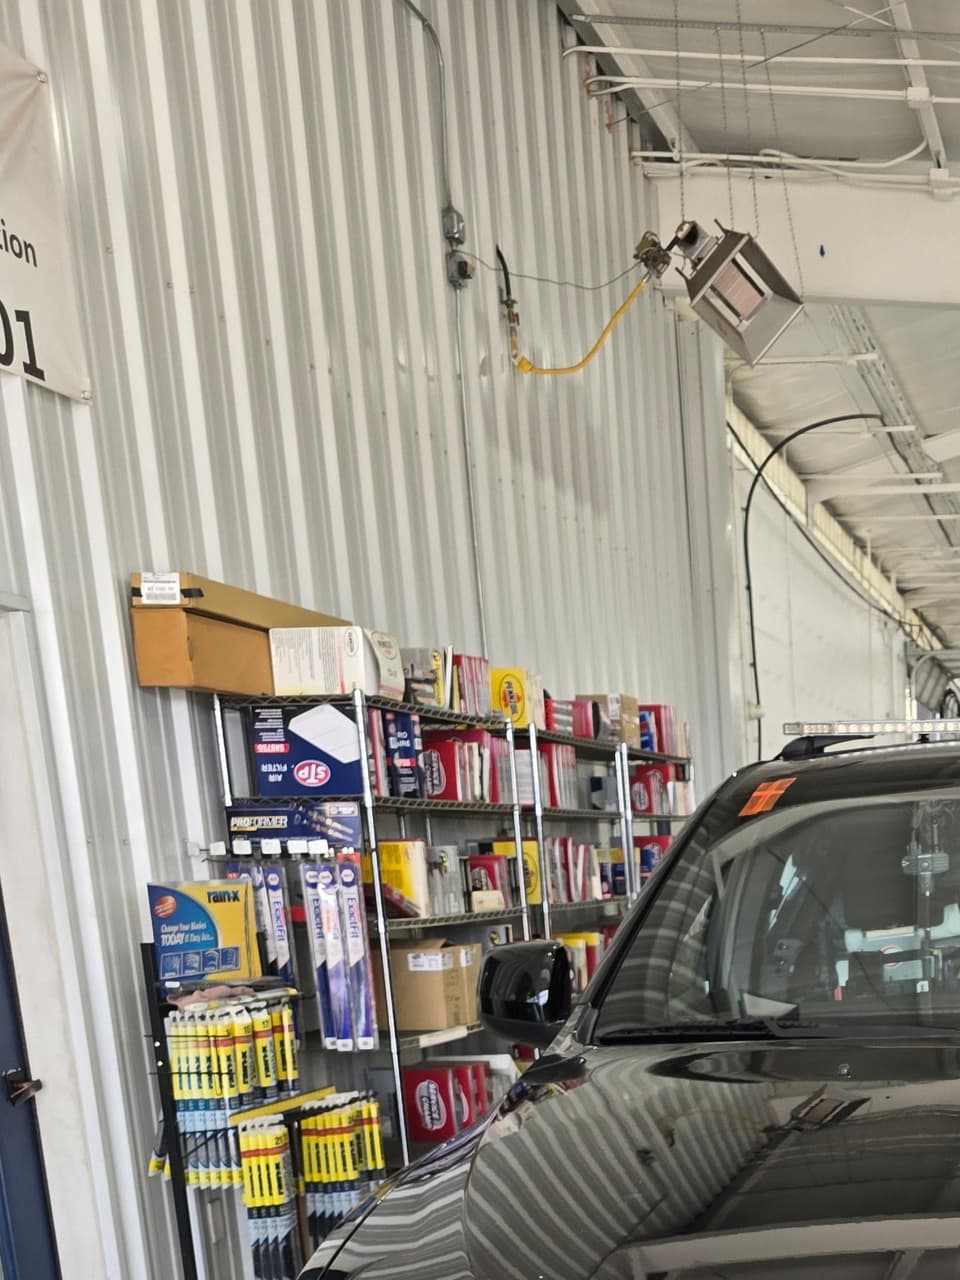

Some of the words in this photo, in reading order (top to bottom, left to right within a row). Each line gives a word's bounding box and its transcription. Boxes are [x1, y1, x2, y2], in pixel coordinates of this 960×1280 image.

[260, 763, 288, 773] FILTER
[300, 764, 327, 784] STP
[268, 773, 283, 783] AIR
[346, 896, 360, 939] ExactFit
[160, 932, 185, 947] TODAY
[429, 1083, 441, 1119] SERVICE
